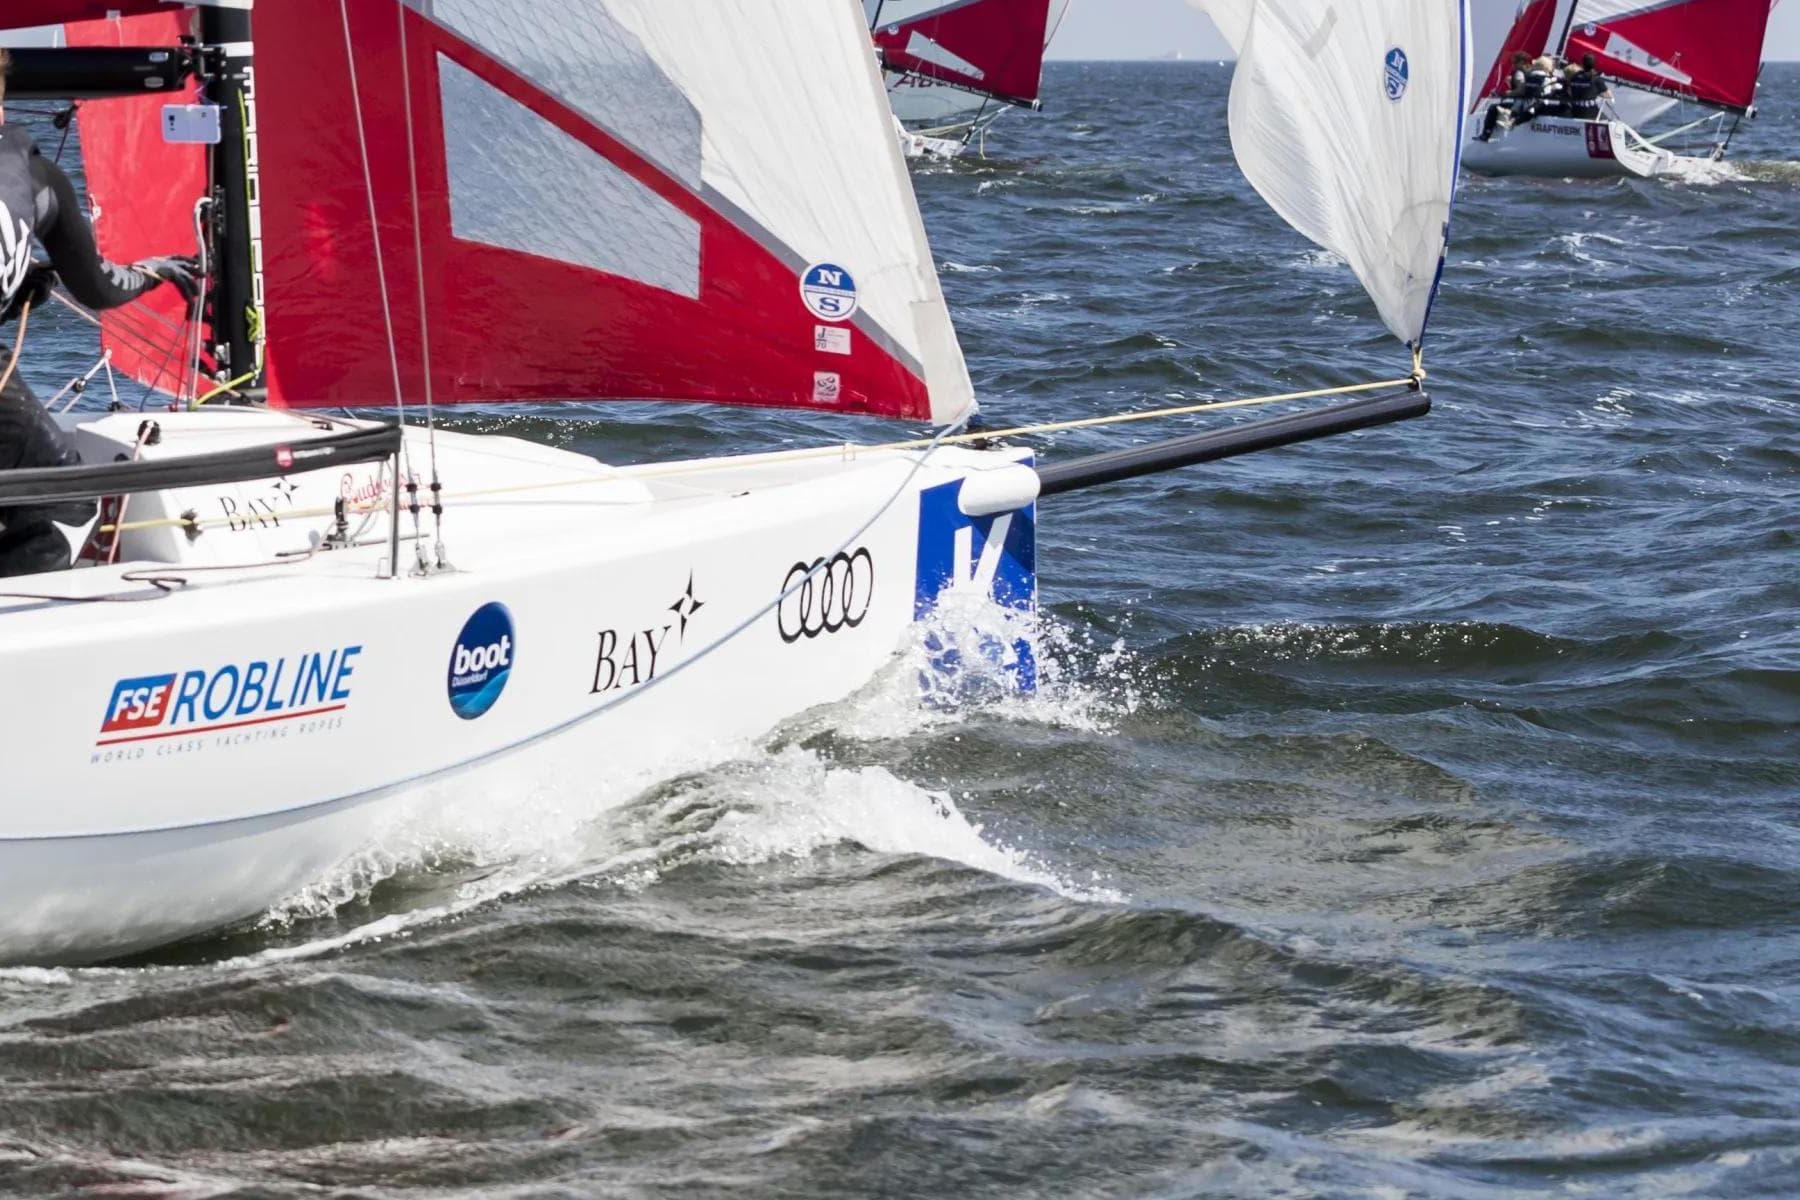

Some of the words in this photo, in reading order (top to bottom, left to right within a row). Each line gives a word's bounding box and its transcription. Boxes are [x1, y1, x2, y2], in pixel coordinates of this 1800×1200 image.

[818, 268, 843, 286] N
[819, 297, 840, 312] S
[453, 634, 511, 675] boot
[588, 625, 672, 694] BAY
[111, 683, 169, 723] FSE
[170, 645, 363, 727] ROBLINE
